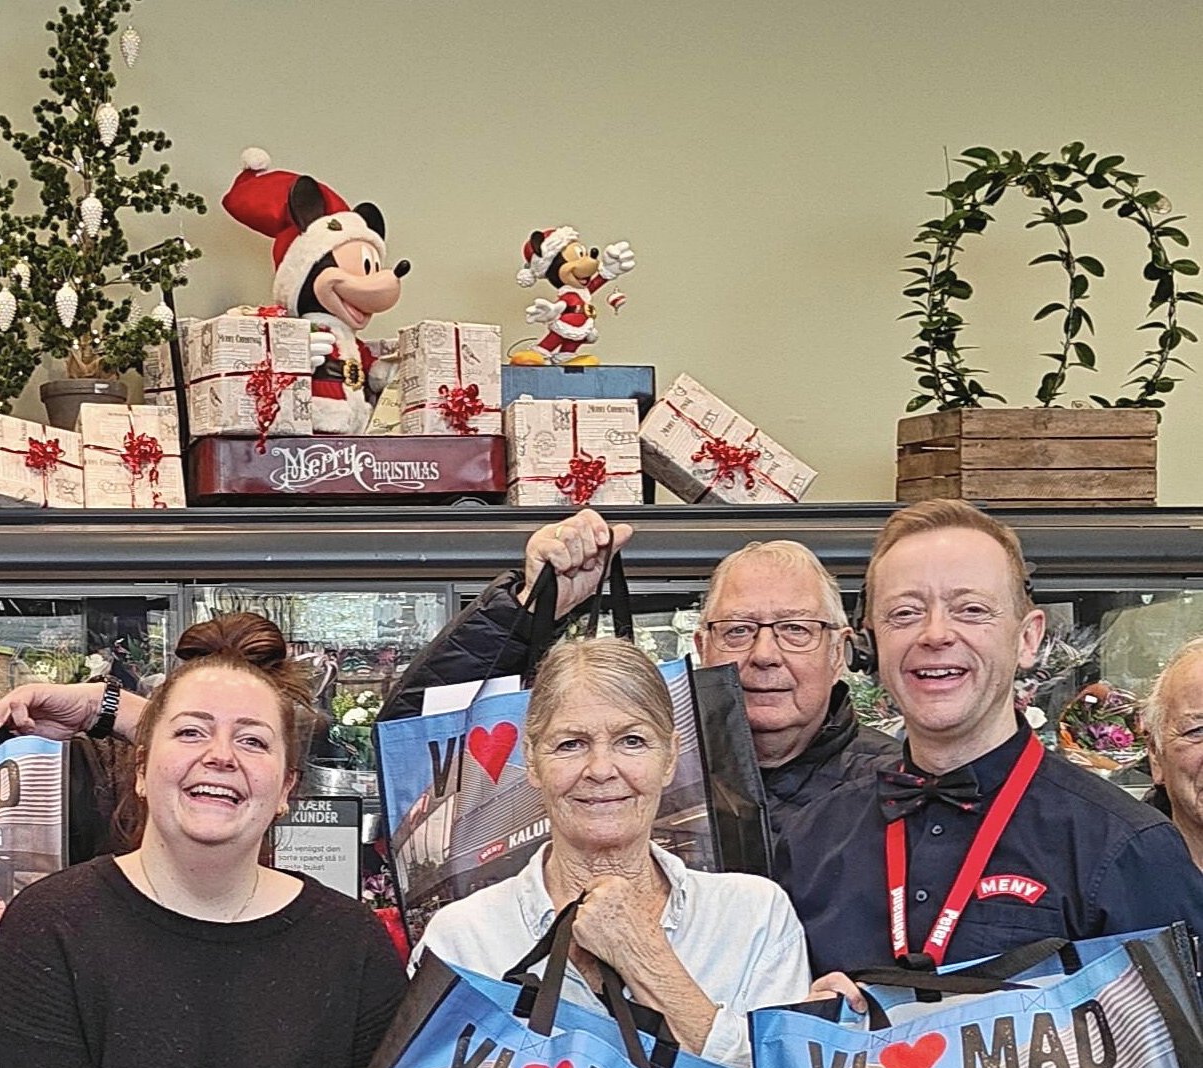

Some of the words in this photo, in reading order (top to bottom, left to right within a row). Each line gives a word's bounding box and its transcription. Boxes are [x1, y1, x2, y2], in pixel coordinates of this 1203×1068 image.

[428, 733, 466, 798] VI
[297, 800, 332, 811] KÆRE
[290, 811, 339, 823] KUNDER
[979, 878, 1039, 897] MENY
[930, 908, 960, 947] Peter
